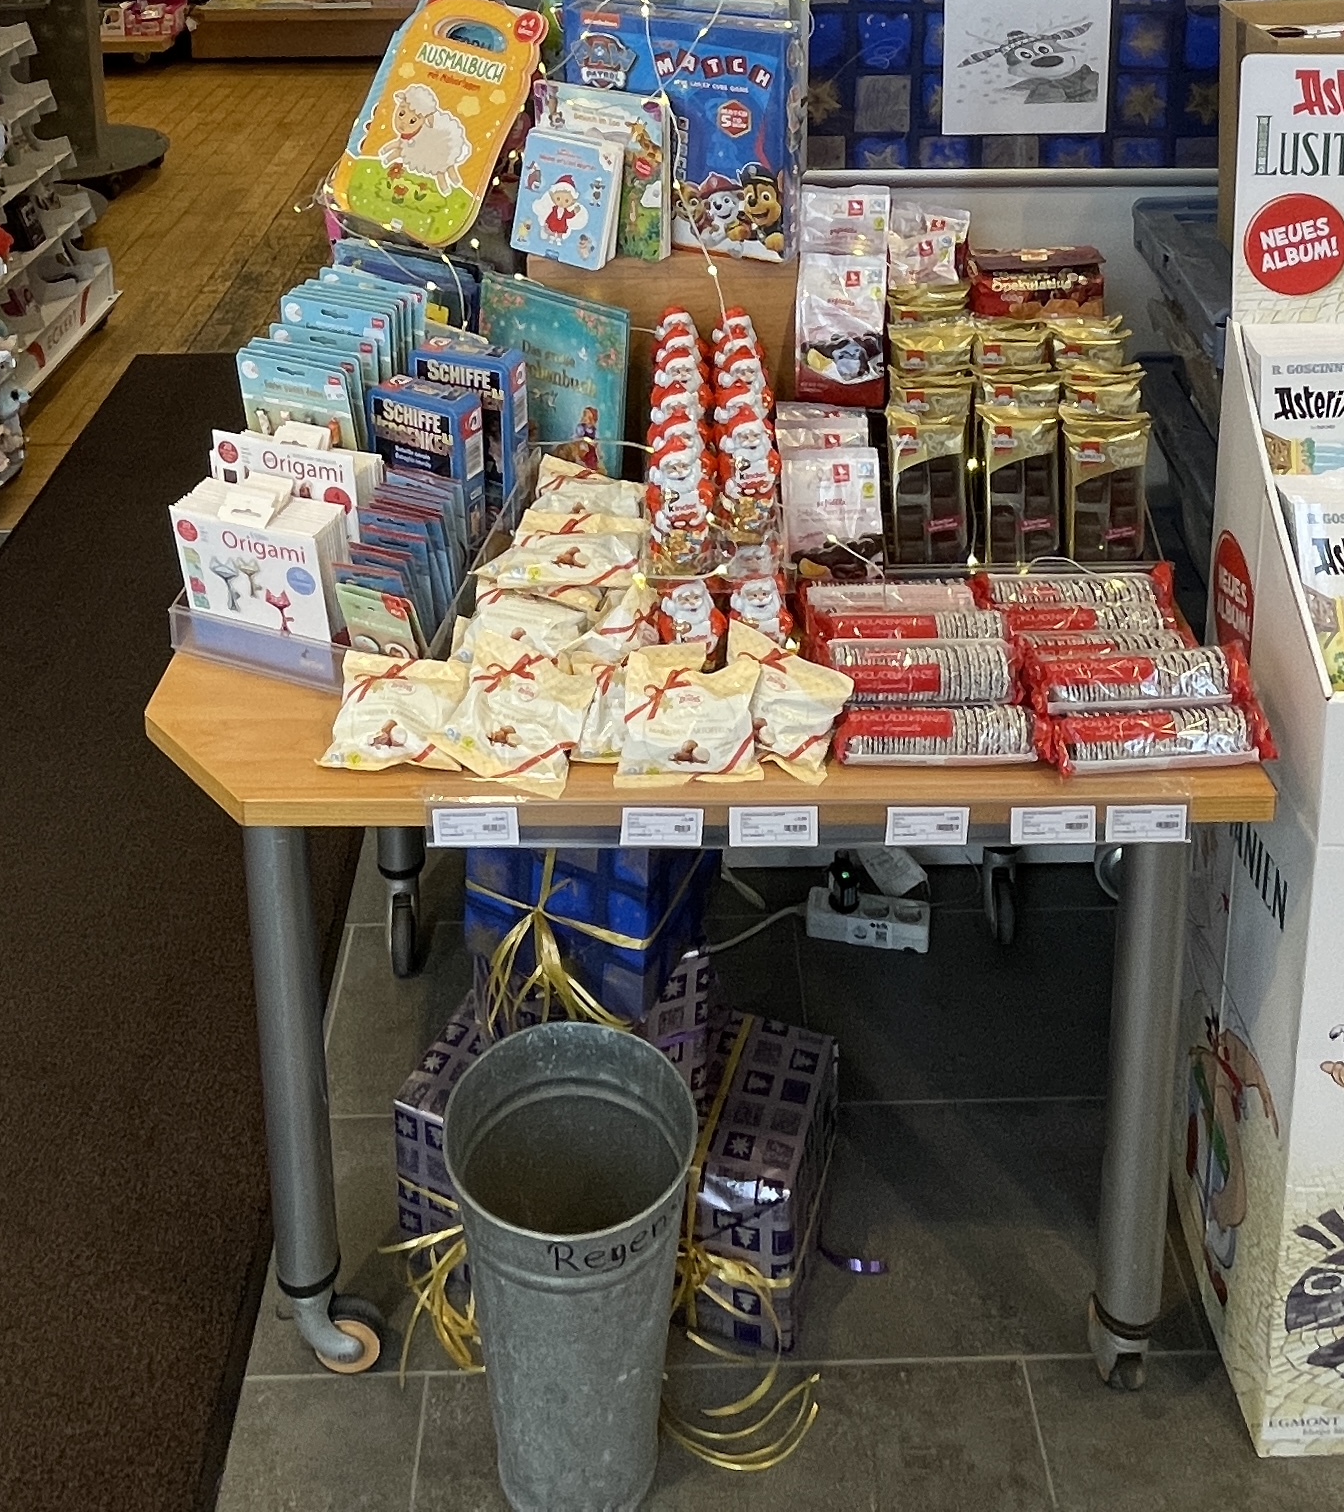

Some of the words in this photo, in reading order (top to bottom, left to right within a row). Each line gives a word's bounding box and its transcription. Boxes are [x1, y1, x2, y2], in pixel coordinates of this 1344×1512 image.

[416, 43, 506, 85] AUSMALBUCH
[585, 70, 621, 83] PATROL
[656, 53, 772, 89] MATCH
[720, 114, 732, 129] 5
[1259, 217, 1331, 251] NEUES
[1260, 235, 1340, 274] ALBUM!
[426, 359, 492, 390] SCHIFFE
[382, 398, 442, 434] SCHIFFE
[262, 450, 344, 484] Origami
[668, 502, 697, 513] kinder
[222, 530, 307, 565] Origami
[1268, 1416, 1342, 1429] EGMONT
